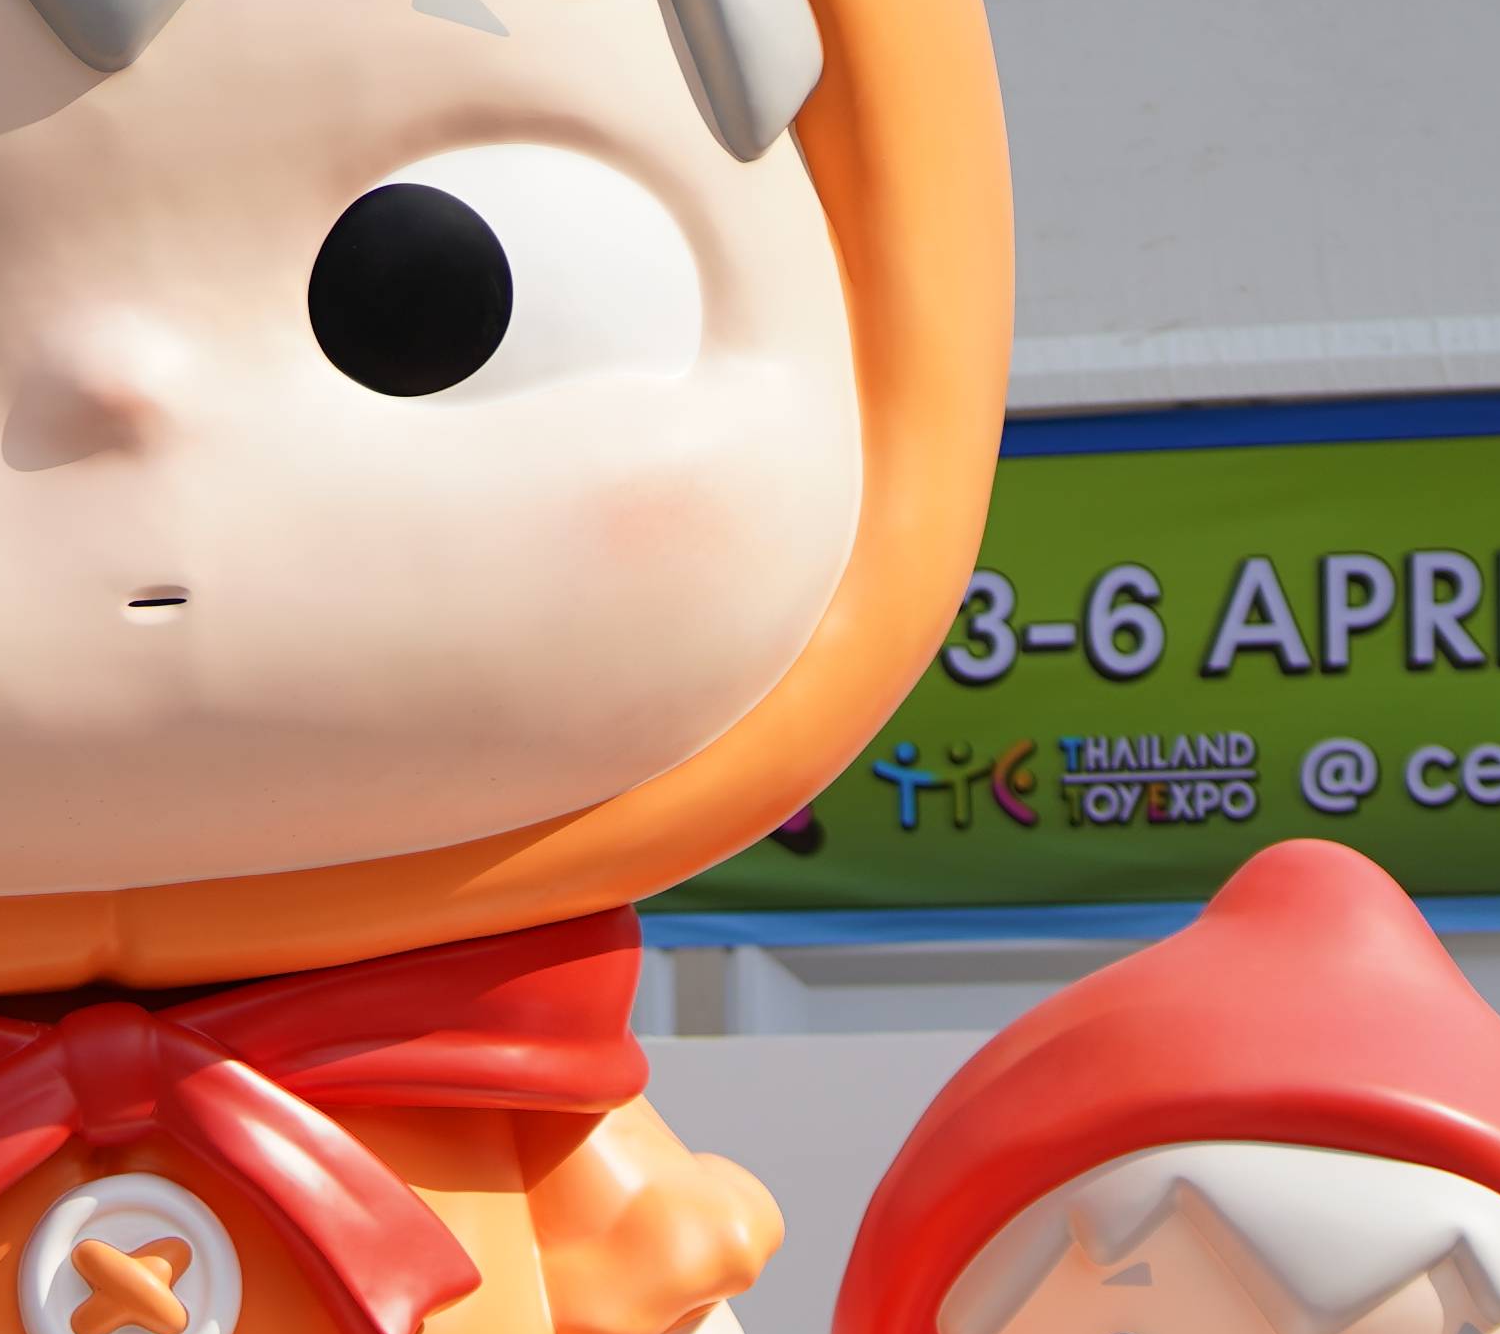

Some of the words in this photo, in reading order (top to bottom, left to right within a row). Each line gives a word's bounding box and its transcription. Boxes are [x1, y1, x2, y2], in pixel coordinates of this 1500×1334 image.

[942, 562, 1165, 682] 3-6
[1059, 731, 1256, 772] THAILAND
[1300, 737, 1379, 814] @
[1065, 784, 1144, 825] TOY
[1147, 780, 1257, 824] EXPO
